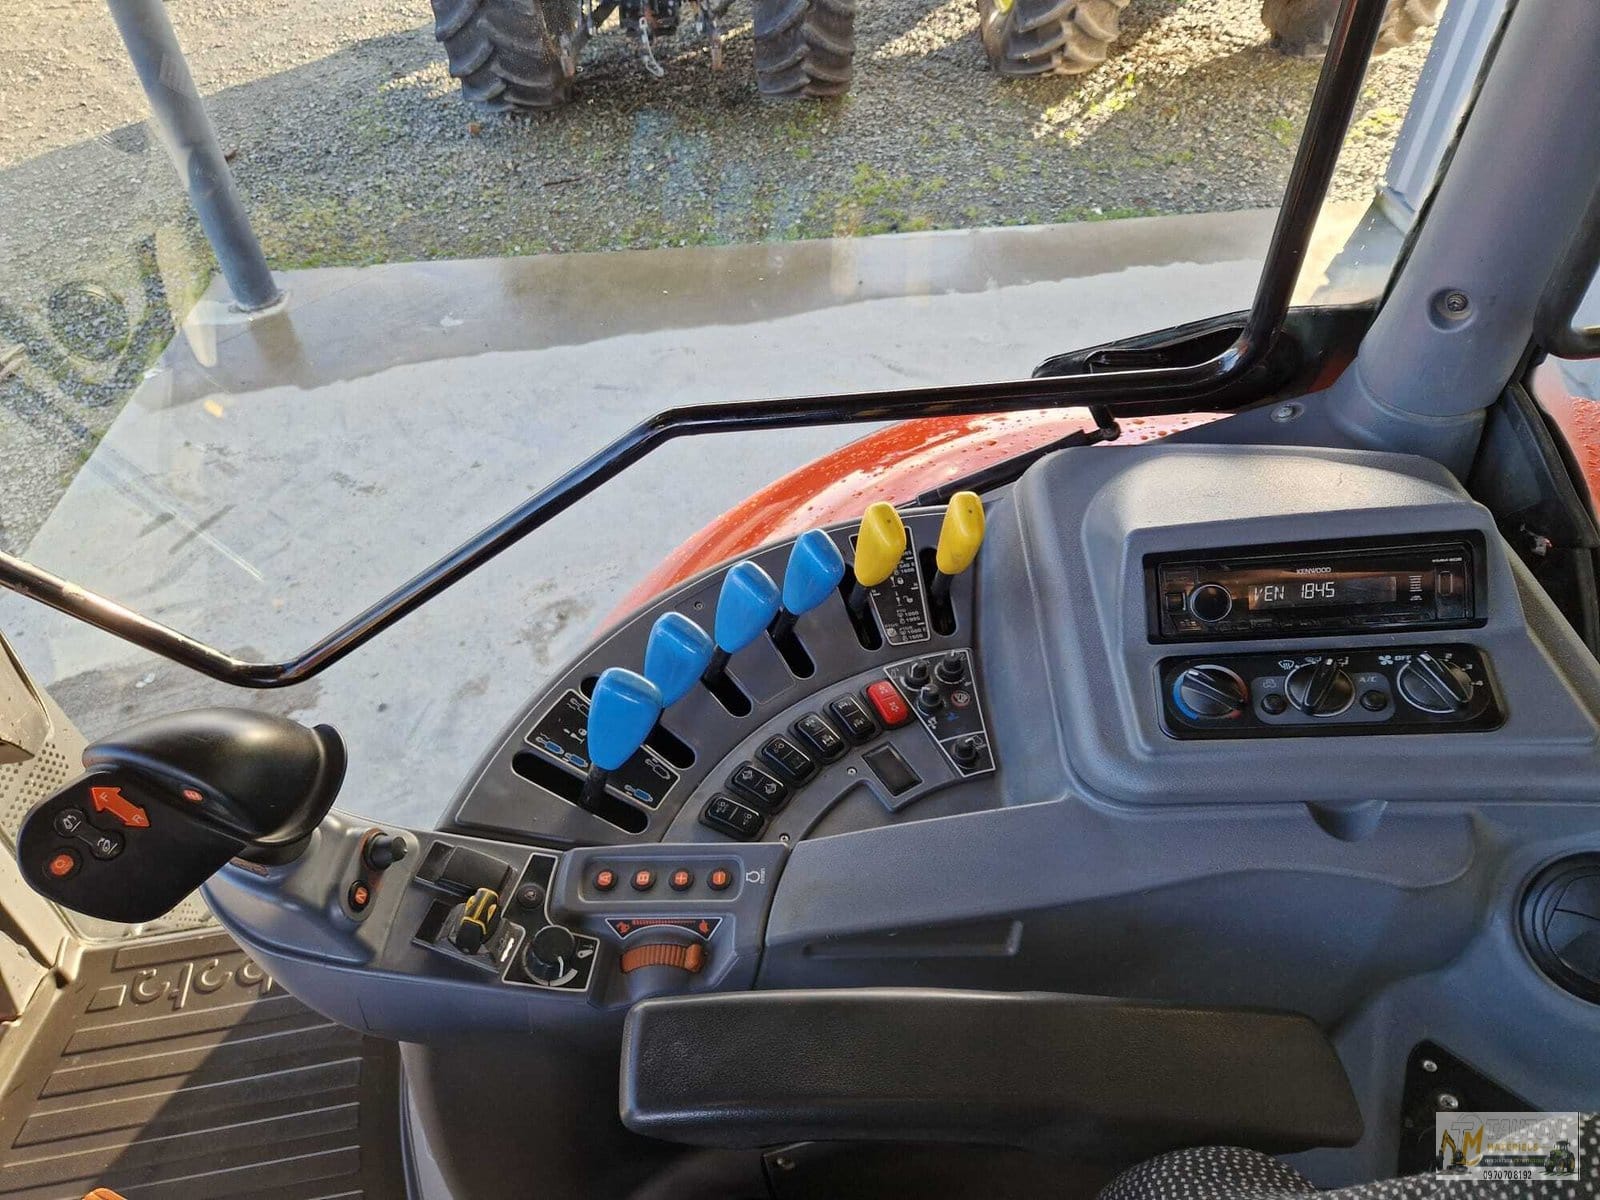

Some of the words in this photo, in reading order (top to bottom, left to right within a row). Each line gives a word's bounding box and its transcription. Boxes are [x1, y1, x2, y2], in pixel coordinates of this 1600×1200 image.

[1295, 566, 1332, 575] KENWOOD
[1300, 581, 1336, 600] 1845
[1394, 654, 1412, 662] OFF
[1359, 675, 1377, 684] A/C
[99, 791, 110, 802] F
